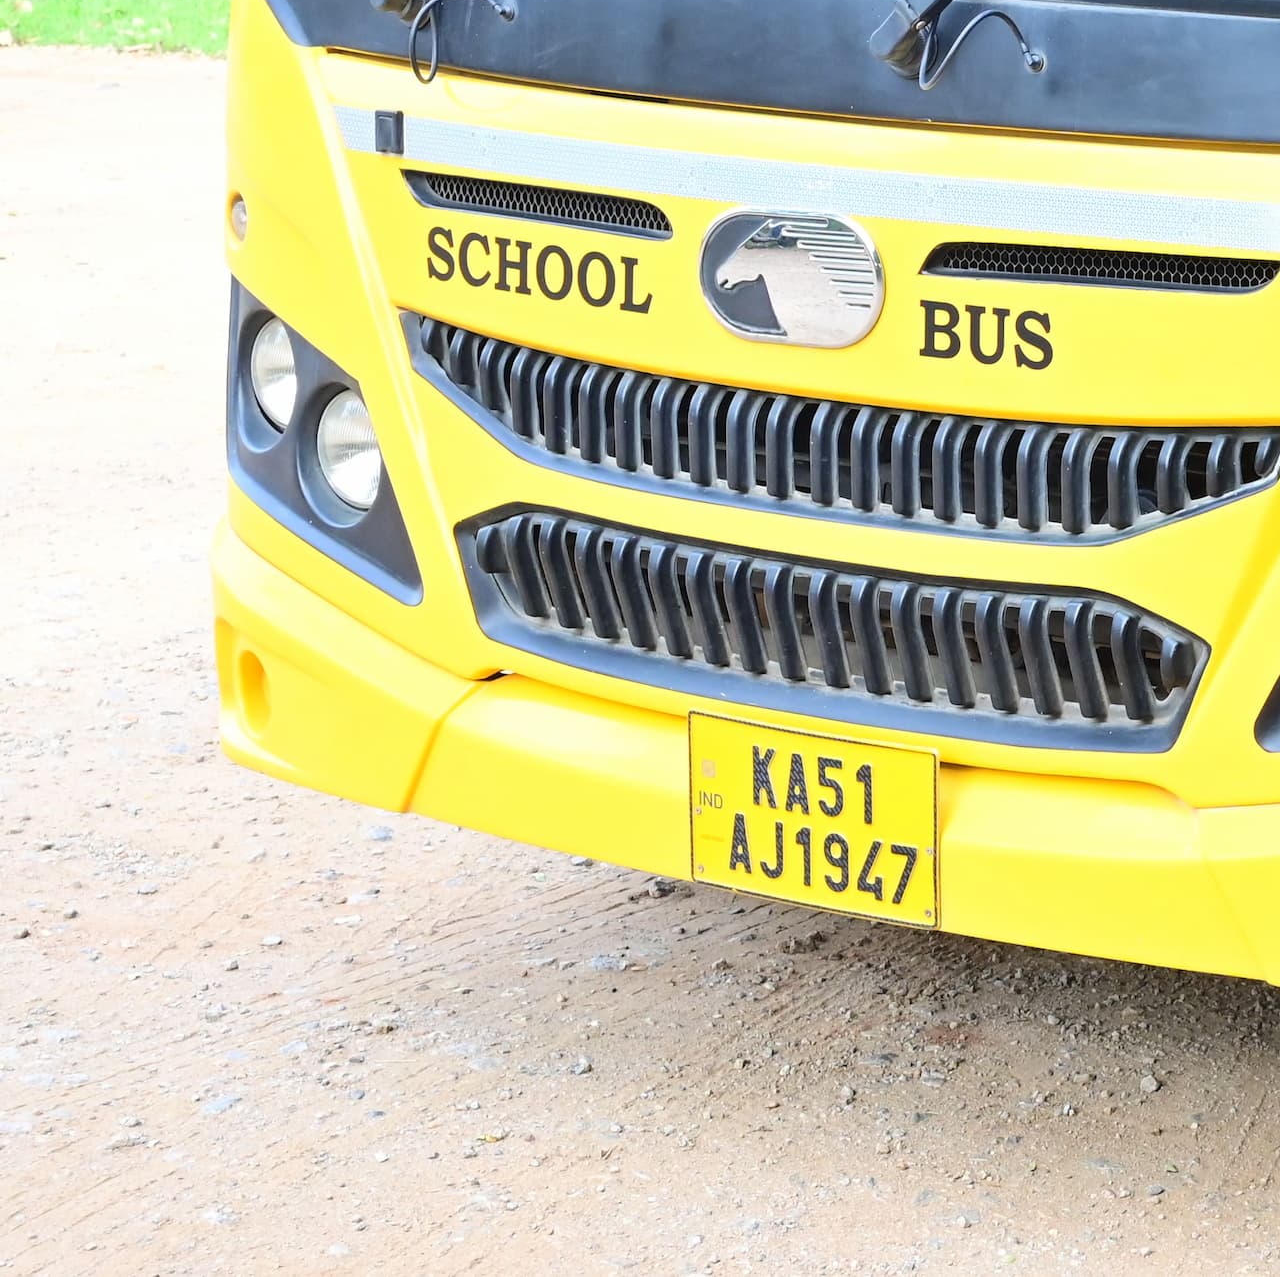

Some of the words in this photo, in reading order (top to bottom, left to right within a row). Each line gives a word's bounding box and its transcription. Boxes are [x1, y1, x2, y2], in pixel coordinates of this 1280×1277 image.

[426, 226, 654, 314] SCHOOL
[918, 300, 1054, 370] BUS
[698, 790, 723, 810] IND
[752, 745, 873, 825] KA51
[729, 813, 918, 905] AJ1947
